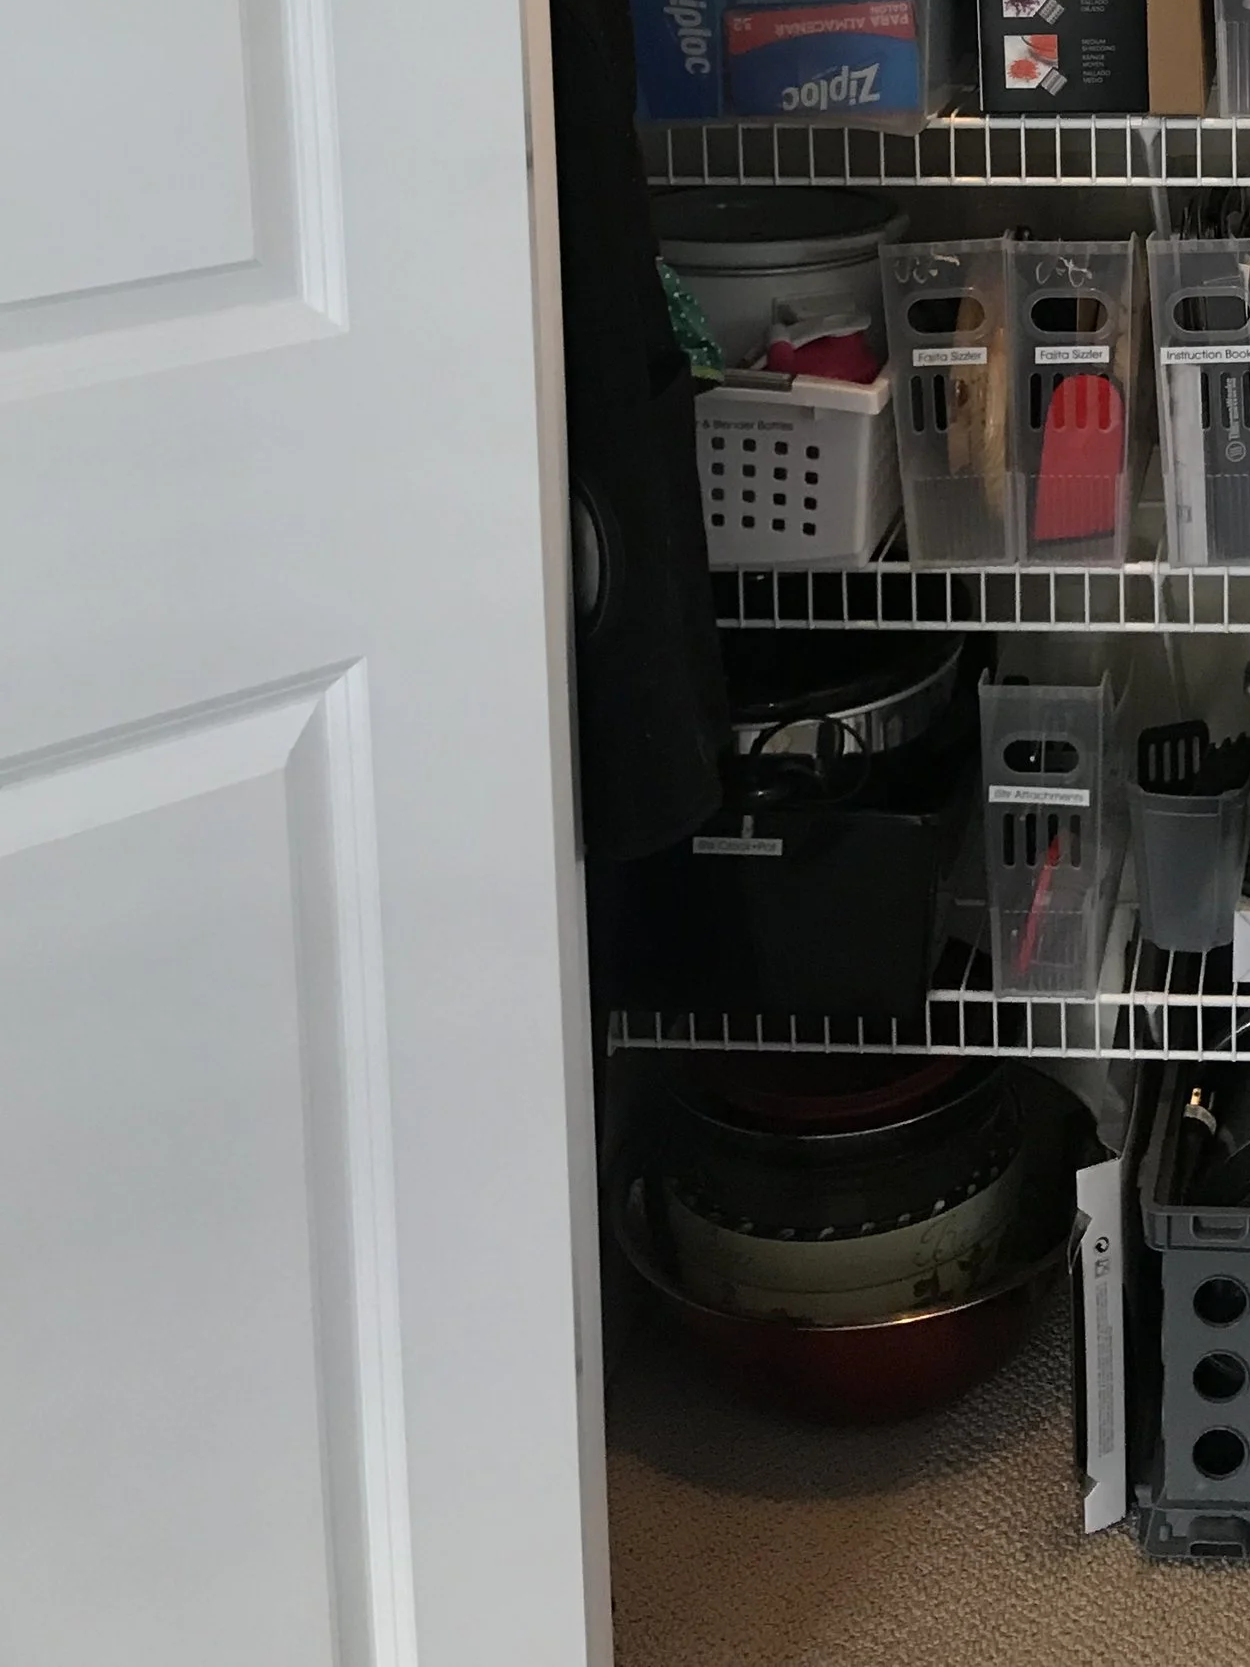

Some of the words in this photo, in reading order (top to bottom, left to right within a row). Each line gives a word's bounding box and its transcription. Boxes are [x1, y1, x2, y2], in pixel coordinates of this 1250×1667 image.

[775, 16, 866, 38] ALMACENAR
[870, 13, 909, 28] PARA
[782, 63, 880, 111] Ziploc
[918, 352, 948, 363] Fajita
[951, 351, 982, 361] Sizzler
[1040, 351, 1069, 361] Fajita
[1072, 349, 1103, 360] Sizzler
[1166, 350, 1222, 360] Instruction
